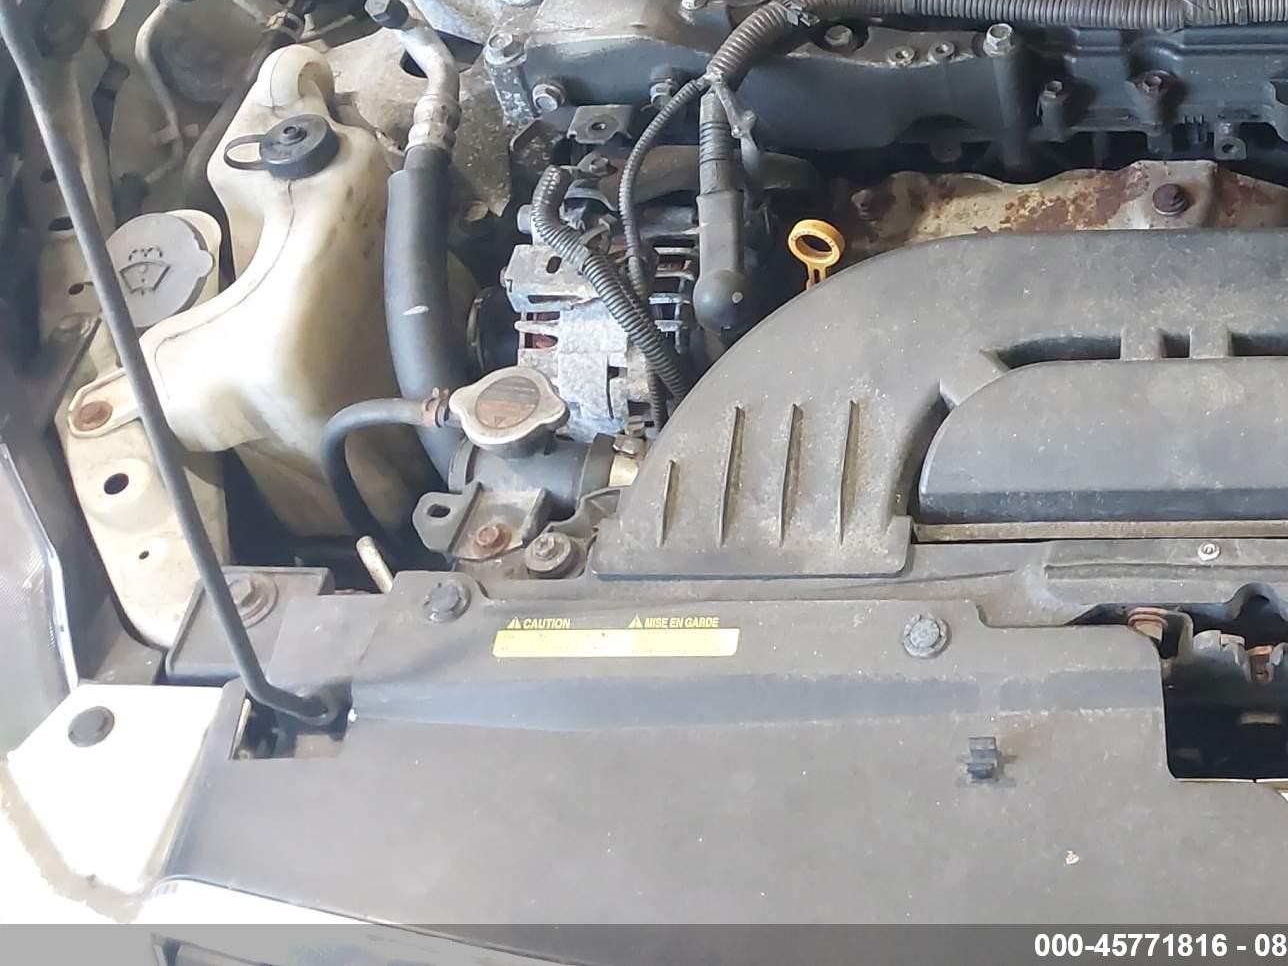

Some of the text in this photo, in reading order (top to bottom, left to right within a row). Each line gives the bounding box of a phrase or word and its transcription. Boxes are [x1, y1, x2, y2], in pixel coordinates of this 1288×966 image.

[522, 618, 571, 630] CAUTION
[644, 617, 719, 629] MISE EN GARDE
